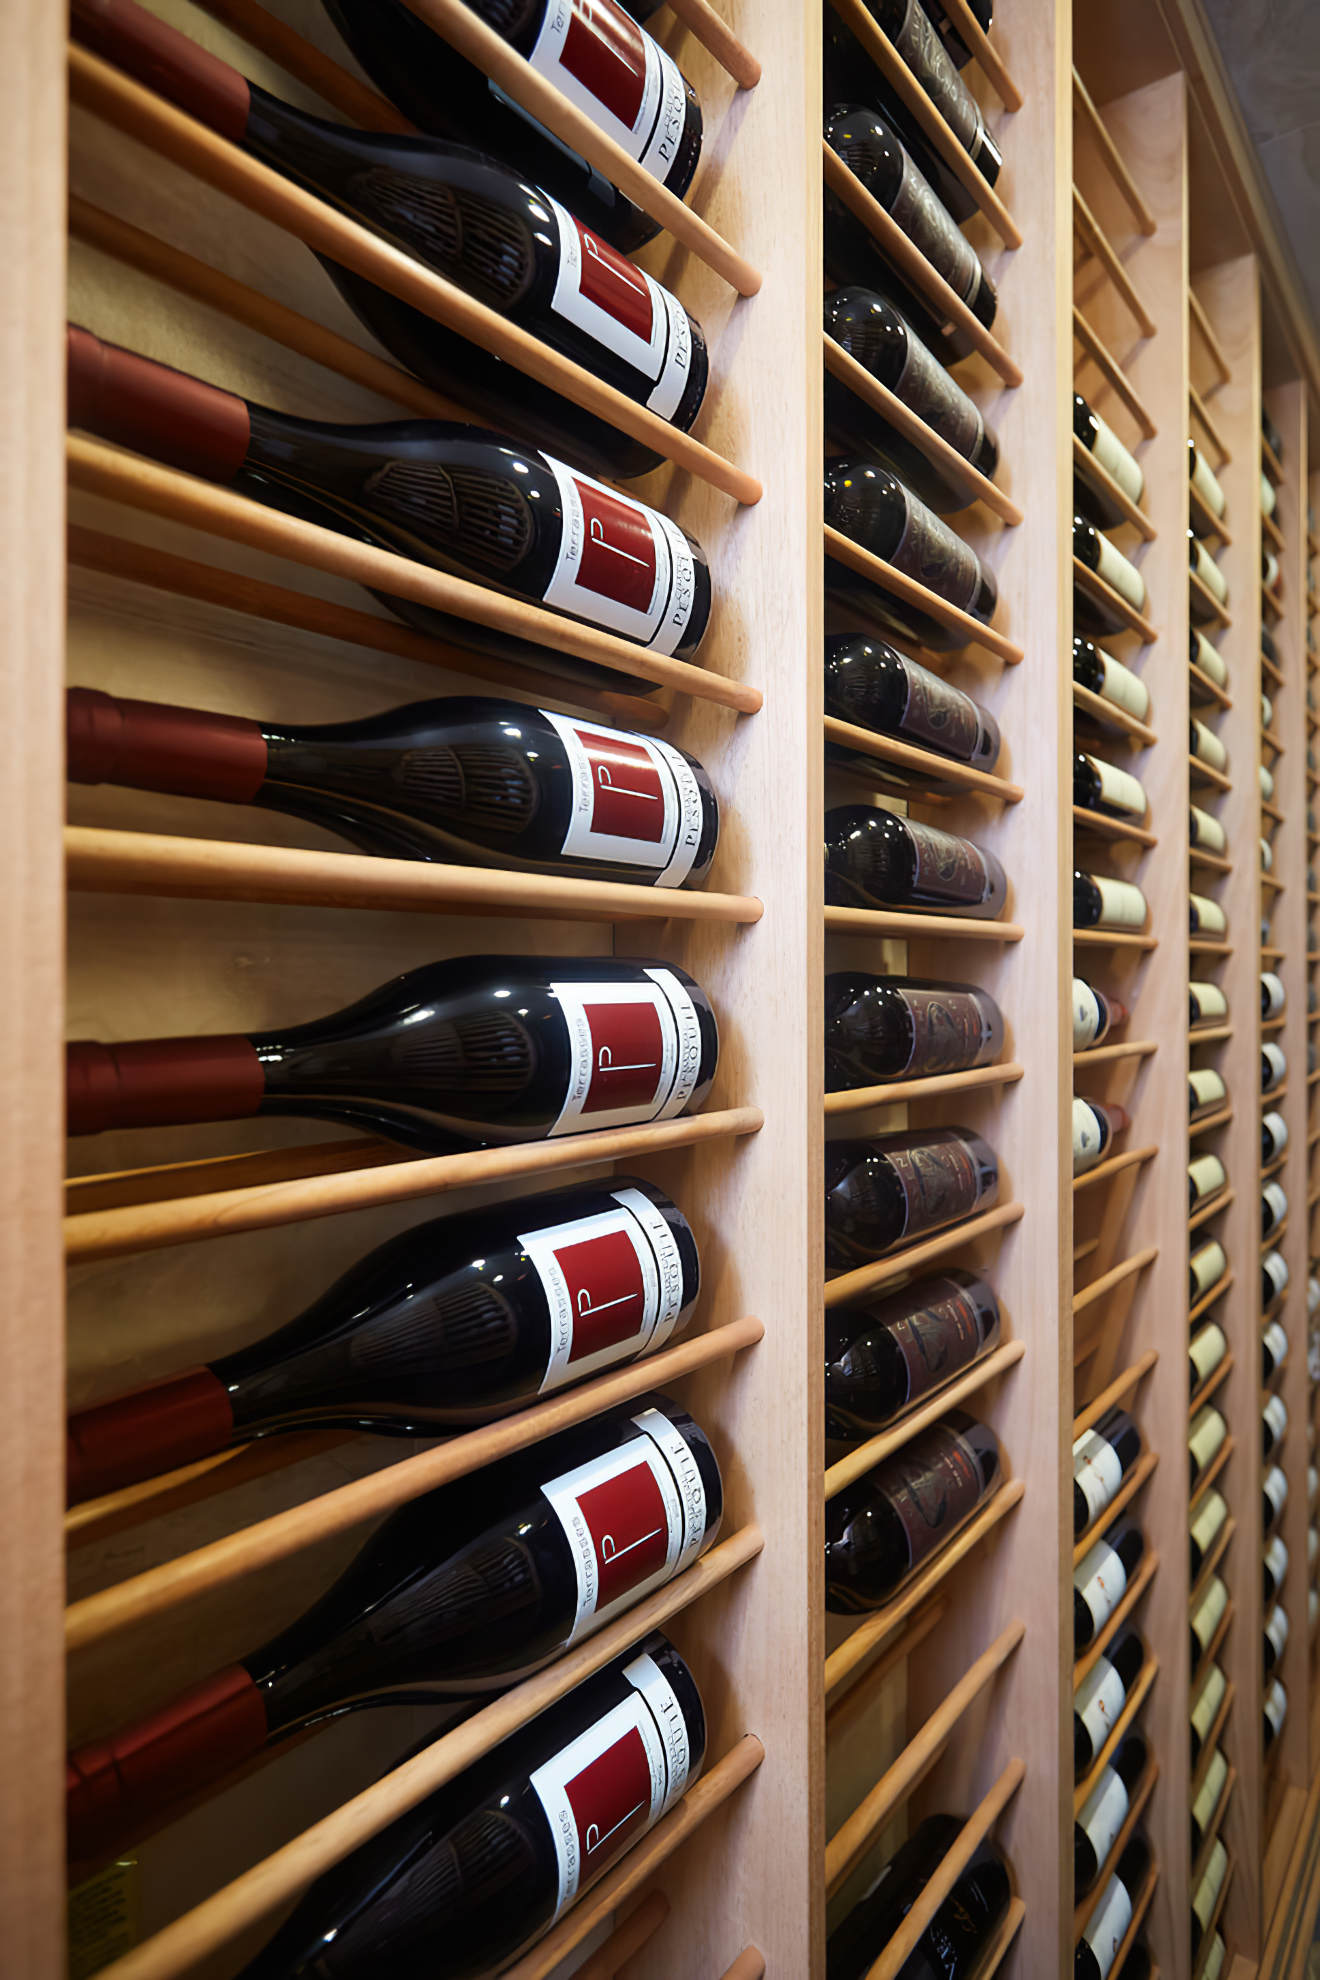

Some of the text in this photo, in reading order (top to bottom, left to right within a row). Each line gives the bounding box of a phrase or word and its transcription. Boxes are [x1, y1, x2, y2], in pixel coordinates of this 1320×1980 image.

[590, 517, 650, 568] P
[597, 765, 659, 800] P
[598, 1045, 657, 1072] P
[577, 1288, 638, 1317] P
[601, 1527, 663, 1565] P
[586, 1799, 646, 1856] P
